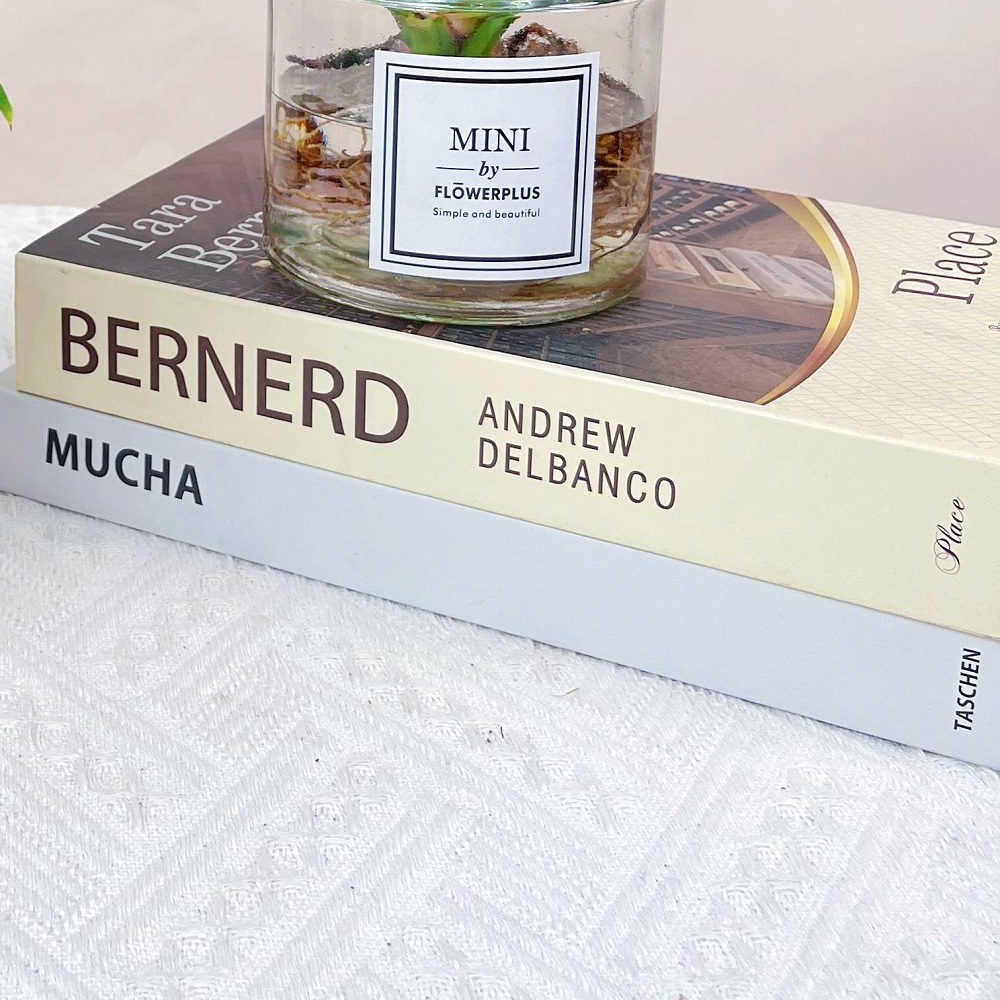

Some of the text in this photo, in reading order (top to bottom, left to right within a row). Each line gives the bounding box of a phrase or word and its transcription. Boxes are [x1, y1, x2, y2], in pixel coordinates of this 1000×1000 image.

[449, 127, 531, 152] MINI
[478, 161, 500, 180] by
[77, 194, 222, 251] Tara
[432, 207, 541, 219] Simple and beautiful
[891, 231, 998, 305] Place
[60, 306, 410, 444] BERNERD
[478, 397, 637, 458] ANDREW
[45, 427, 204, 505] MUCHA
[478, 437, 677, 510] DELBANCO
[933, 495, 966, 575] Place
[953, 647, 982, 731] TASCHEN
